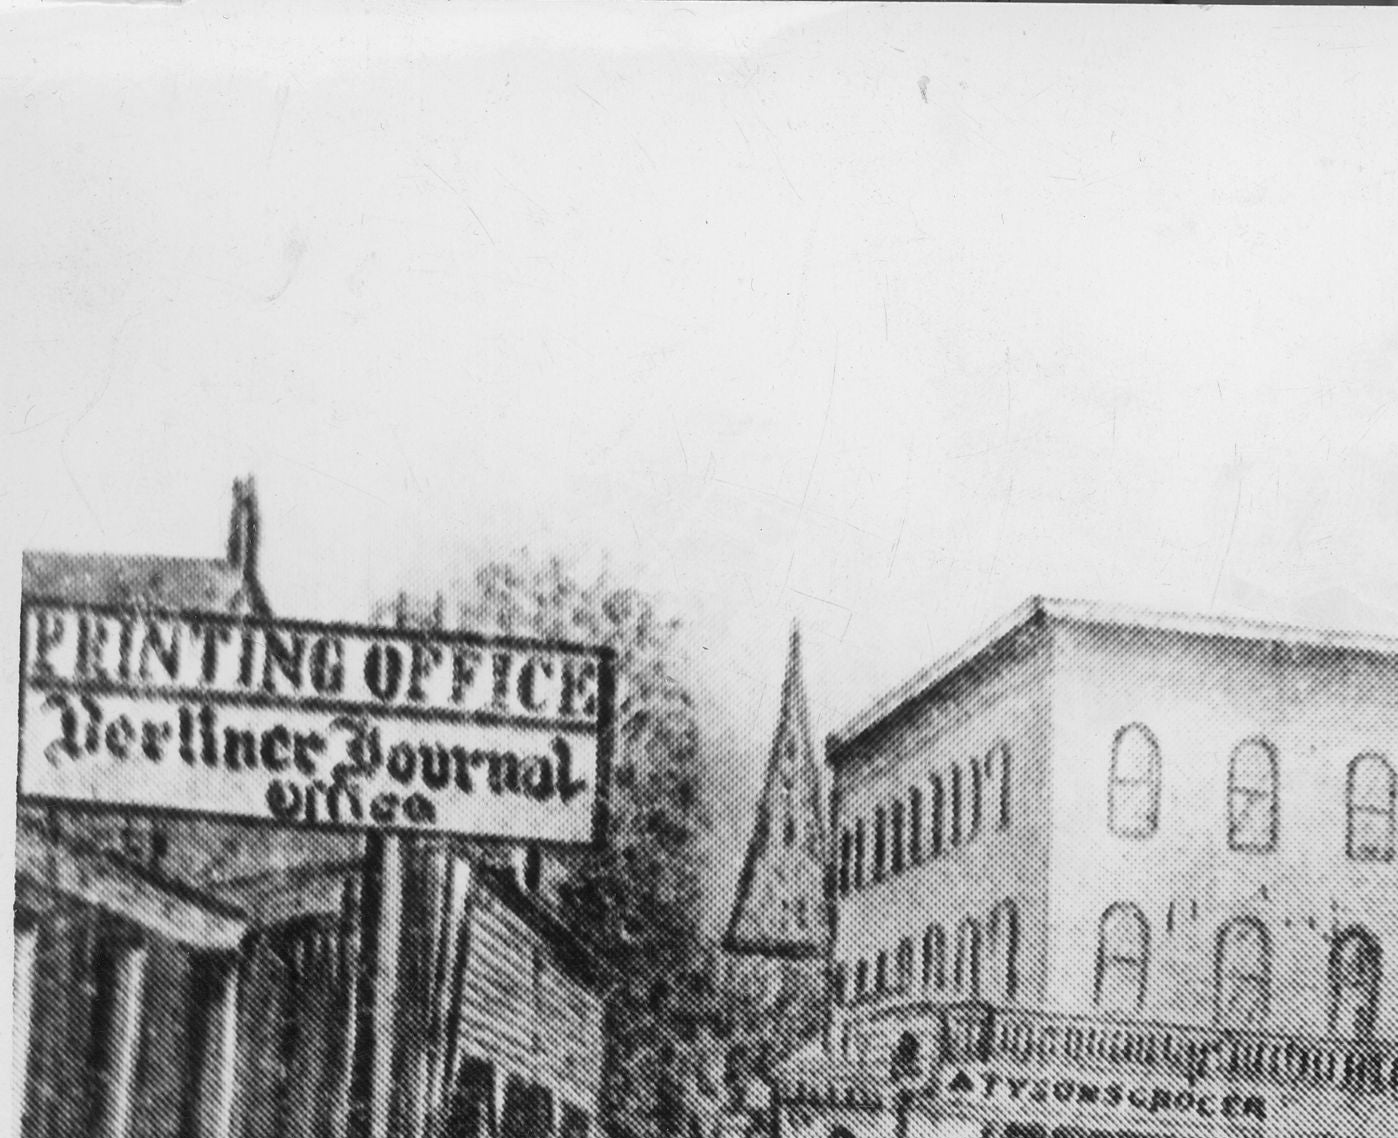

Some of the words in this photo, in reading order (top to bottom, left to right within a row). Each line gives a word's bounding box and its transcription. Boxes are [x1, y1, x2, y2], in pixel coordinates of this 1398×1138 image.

[32, 611, 345, 696] PRINTING
[364, 640, 598, 718] OFFICE
[328, 714, 586, 802] Journal
